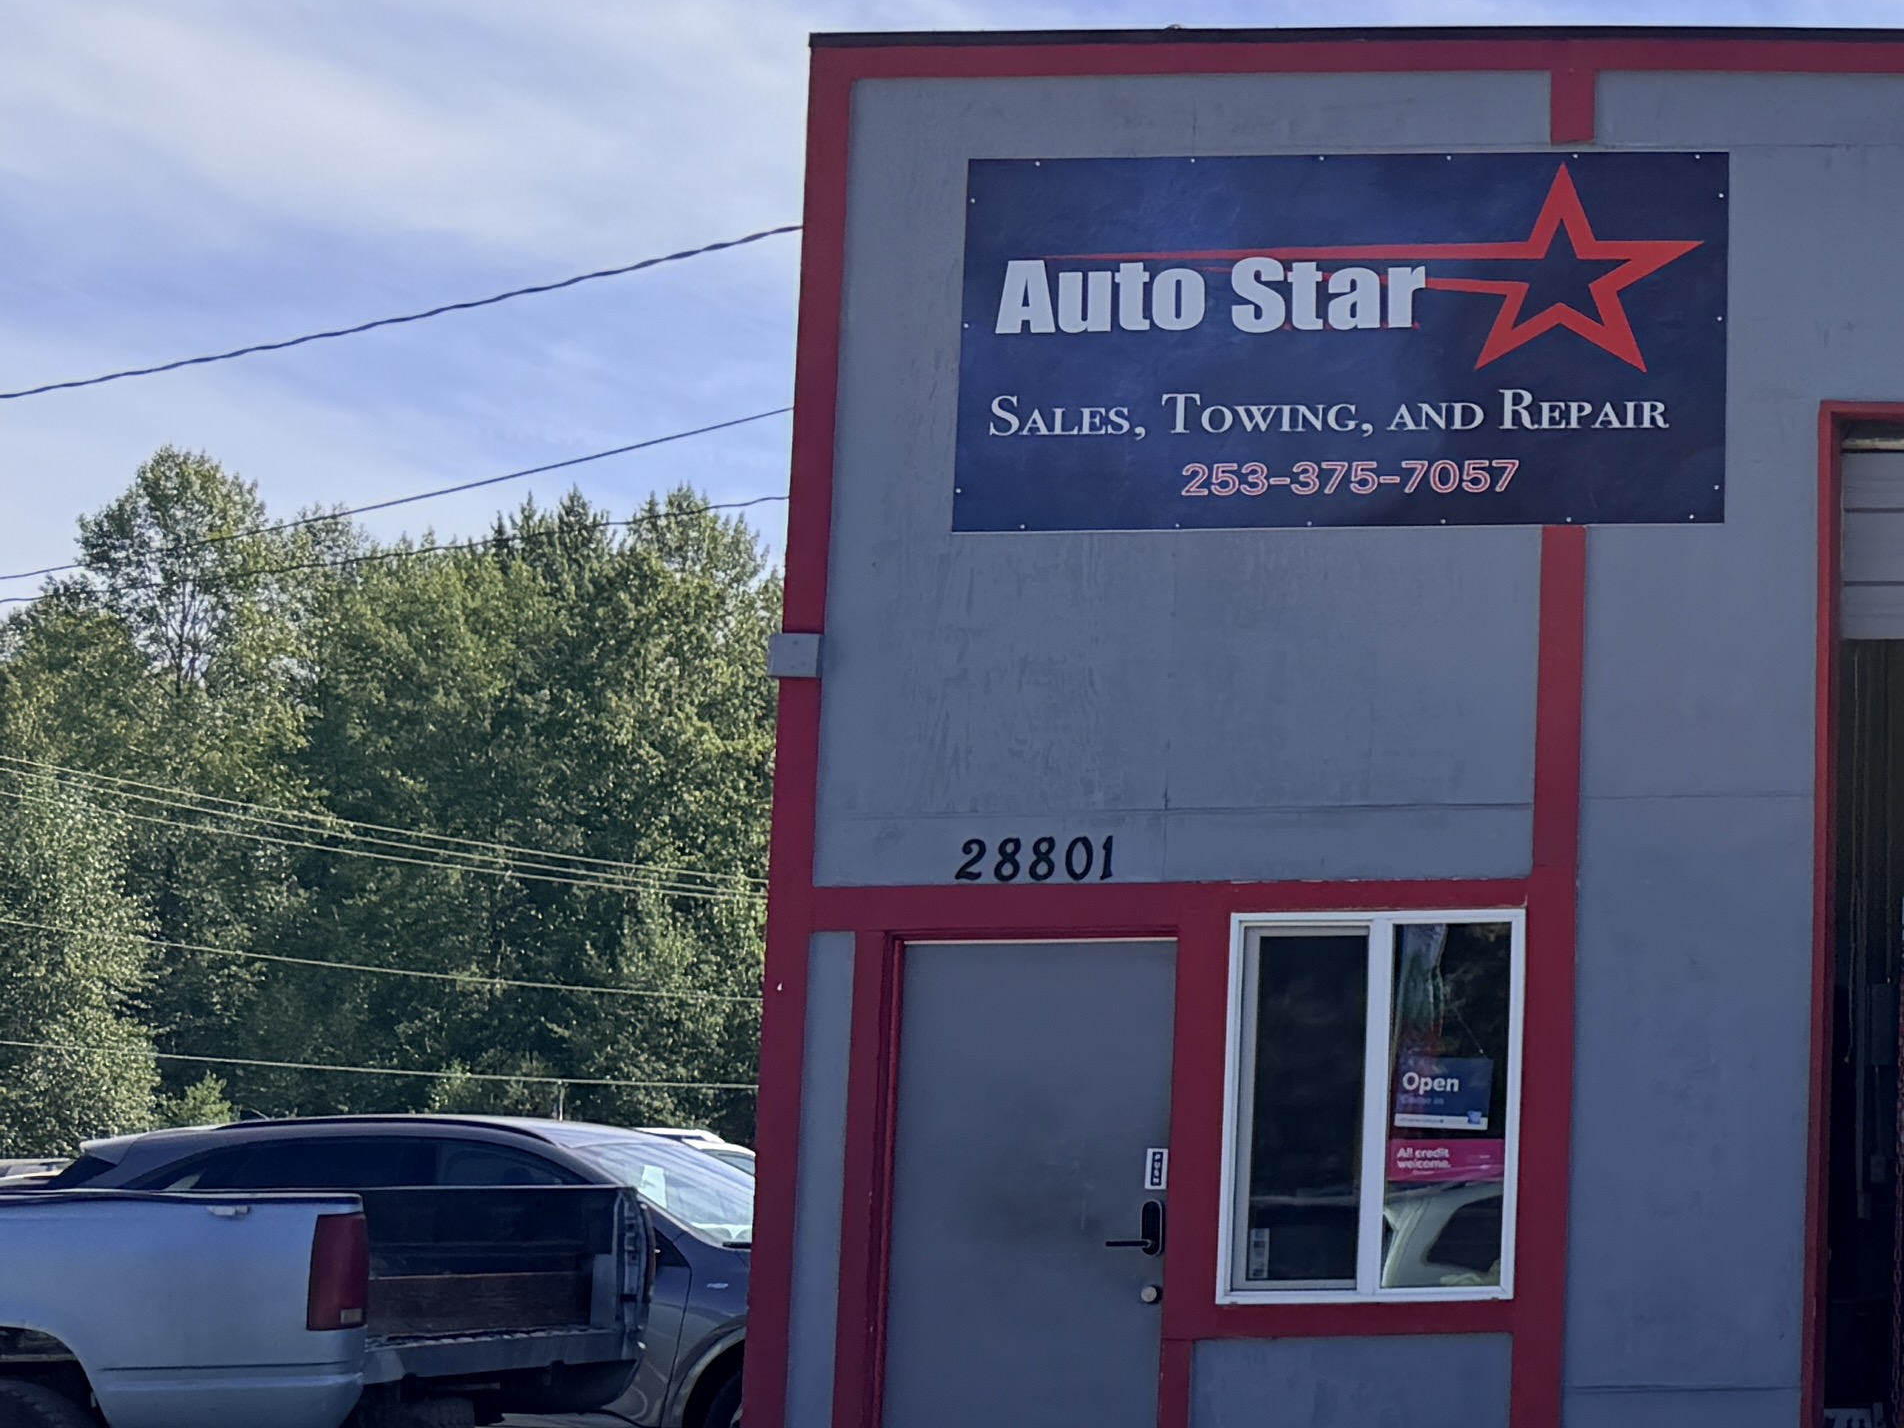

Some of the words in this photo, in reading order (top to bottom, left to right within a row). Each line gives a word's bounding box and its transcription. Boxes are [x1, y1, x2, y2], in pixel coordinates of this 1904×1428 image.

[995, 259, 1206, 334] Auto
[1231, 256, 1427, 334] Star
[1181, 460, 1519, 497] 253-375-7057
[955, 835, 1114, 882] 28801
[1402, 1071, 1459, 1095] Open
[1396, 1147, 1413, 1158] All
